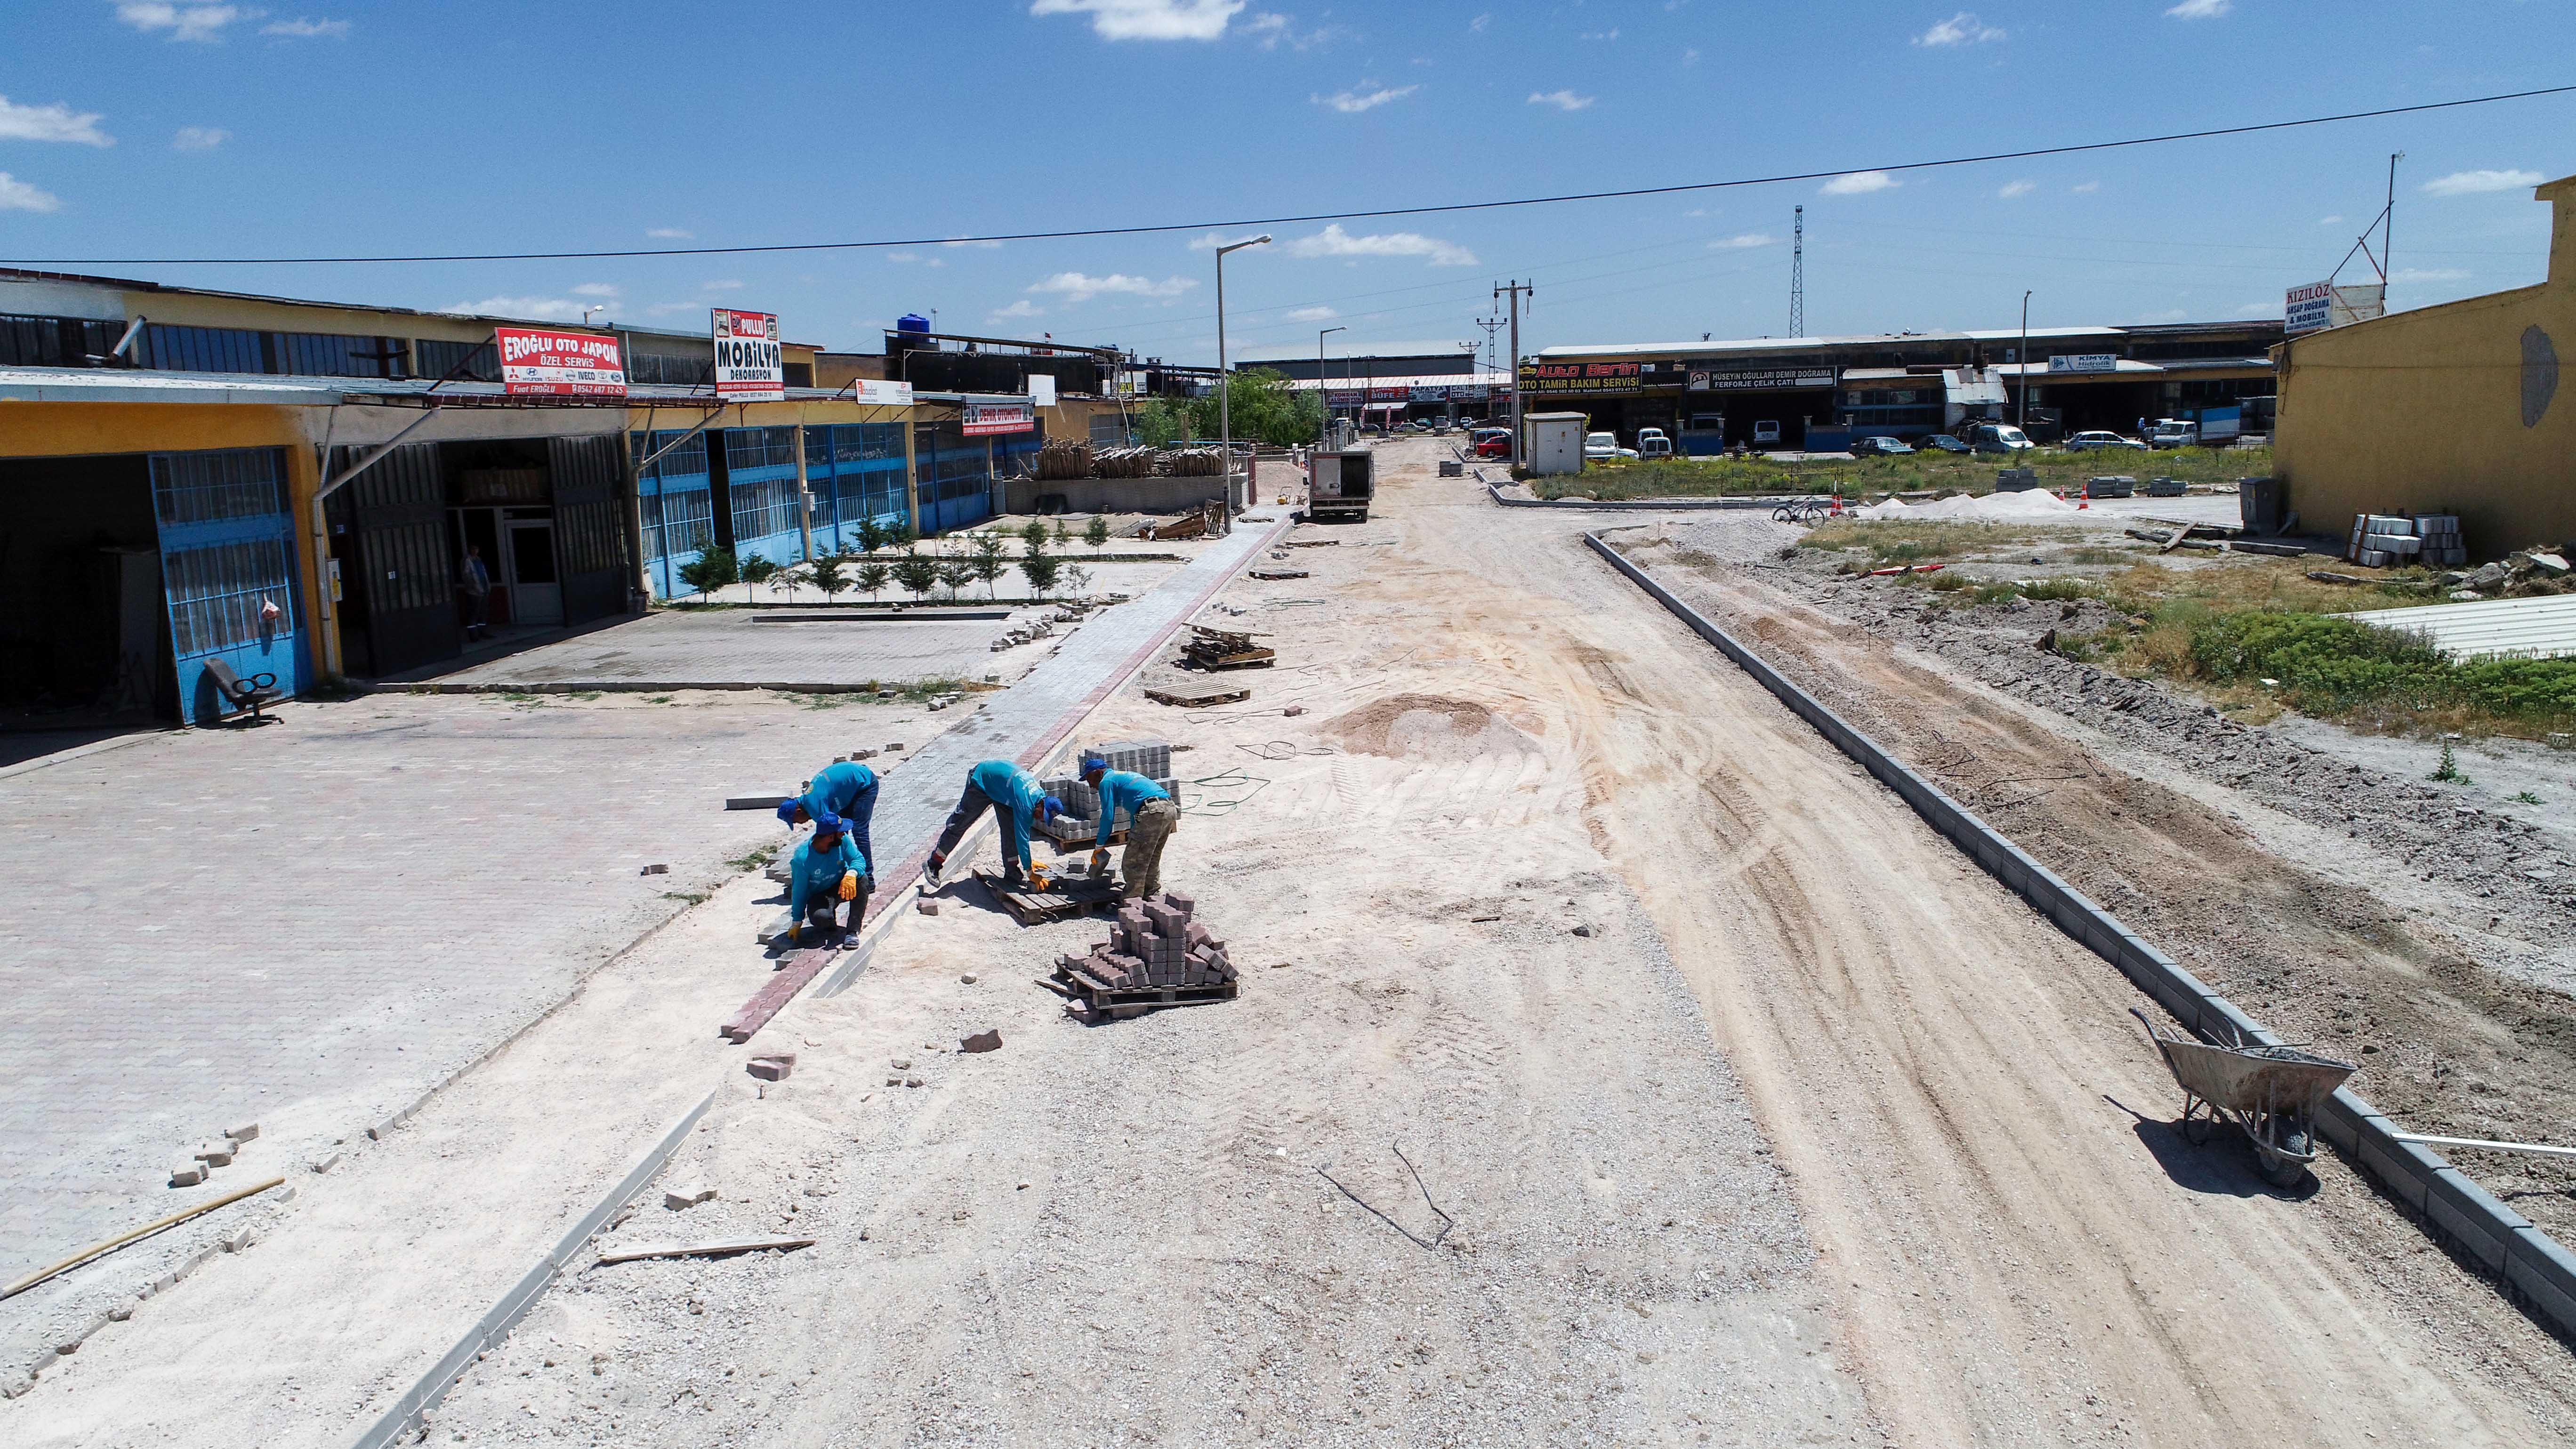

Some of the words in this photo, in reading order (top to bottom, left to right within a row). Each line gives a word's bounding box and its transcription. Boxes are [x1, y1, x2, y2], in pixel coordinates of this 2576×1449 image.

[2287, 283, 2330, 304] KIZILÖZ
[741, 318, 764, 336] PULLU
[504, 334, 552, 362] EROĞLU
[556, 338, 579, 353] OTO
[581, 340, 619, 366] JAPON
[540, 354, 562, 366] ÖZEL
[578, 371, 596, 380] IVECO
[730, 369, 772, 380] DEKORASYON
[1535, 365, 1579, 378] Auto
[1586, 363, 1638, 376] Berlin
[1742, 371, 1774, 379] OĞULLARI
[1798, 369, 1831, 378] DOĞRAMA
[531, 384, 555, 392] EROĞLU
[1519, 380, 1537, 389] OTO
[1570, 378, 1600, 388] BAKIM
